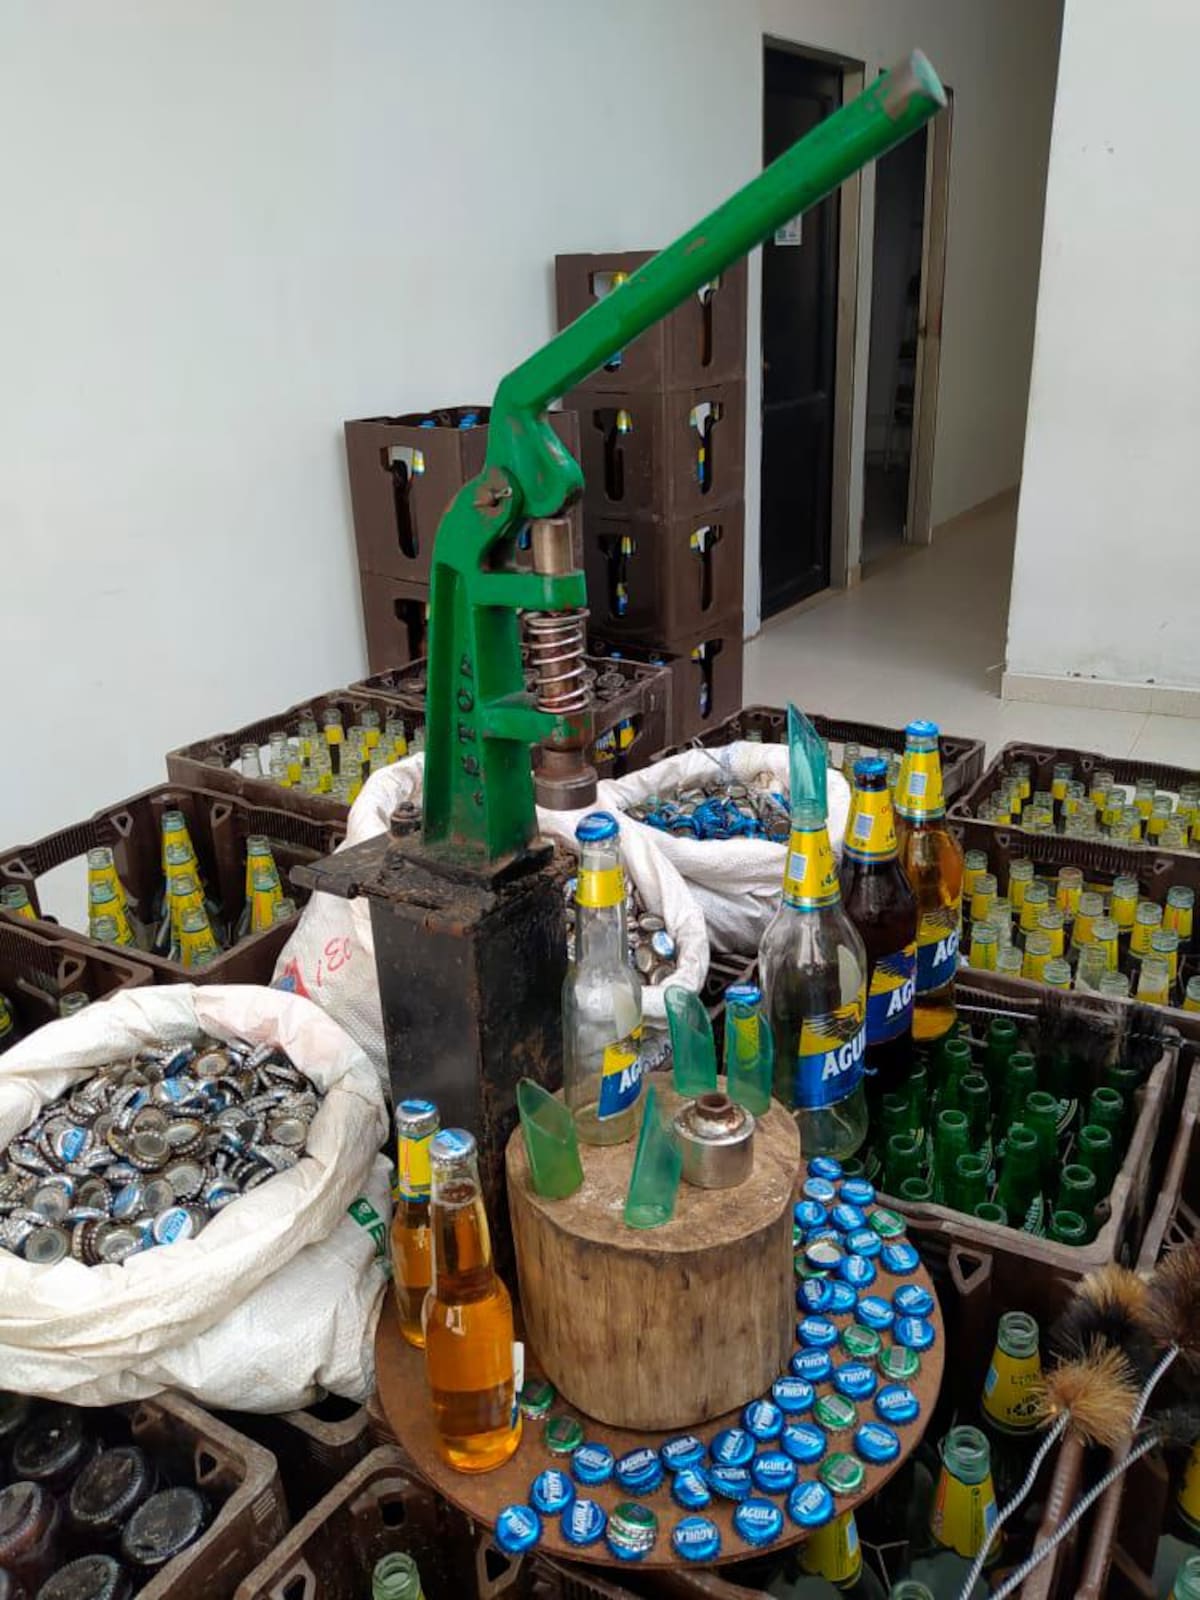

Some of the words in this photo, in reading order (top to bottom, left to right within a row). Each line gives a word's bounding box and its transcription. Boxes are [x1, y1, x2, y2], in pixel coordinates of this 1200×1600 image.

[757, 1459, 793, 1472] AGUILA
[739, 1506, 777, 1521] AGUILA
[677, 1527, 715, 1543] AGUILA
